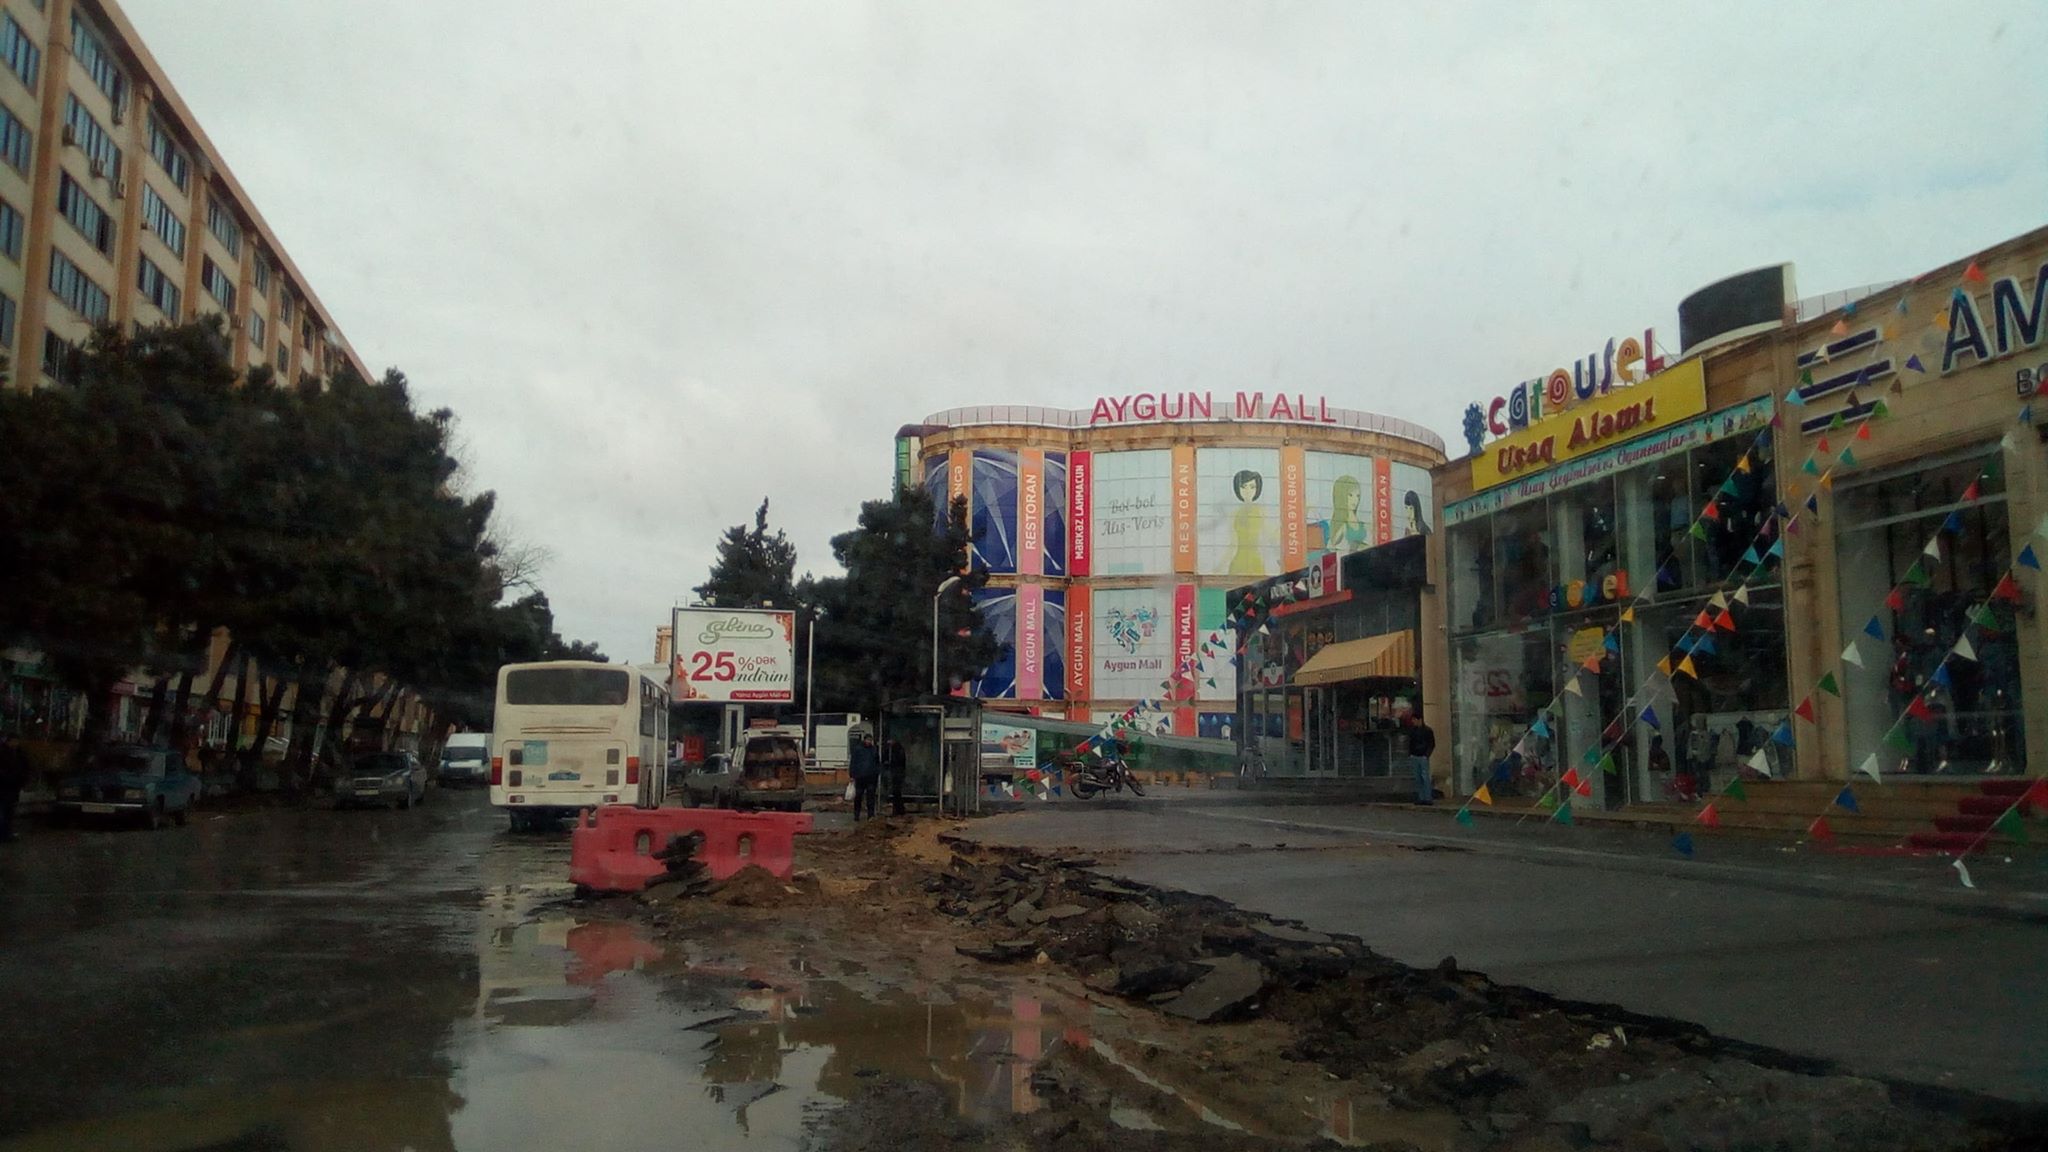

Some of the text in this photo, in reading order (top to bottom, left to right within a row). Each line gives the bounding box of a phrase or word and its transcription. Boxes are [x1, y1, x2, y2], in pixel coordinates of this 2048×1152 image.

[1942, 264, 2048, 372] AM
[1090, 391, 1337, 424] AYGUN MALL
[1025, 474, 1037, 550] RESTORAN
[1074, 464, 1084, 516] LAHMACUN
[1179, 463, 1189, 553] RESTORAN
[1026, 598, 1036, 673] AYGUN MALL
[1074, 610, 1084, 686] AYGUN MALL
[1181, 603, 1191, 635] MALL
[1103, 659, 1162, 673] Aygun Mall
